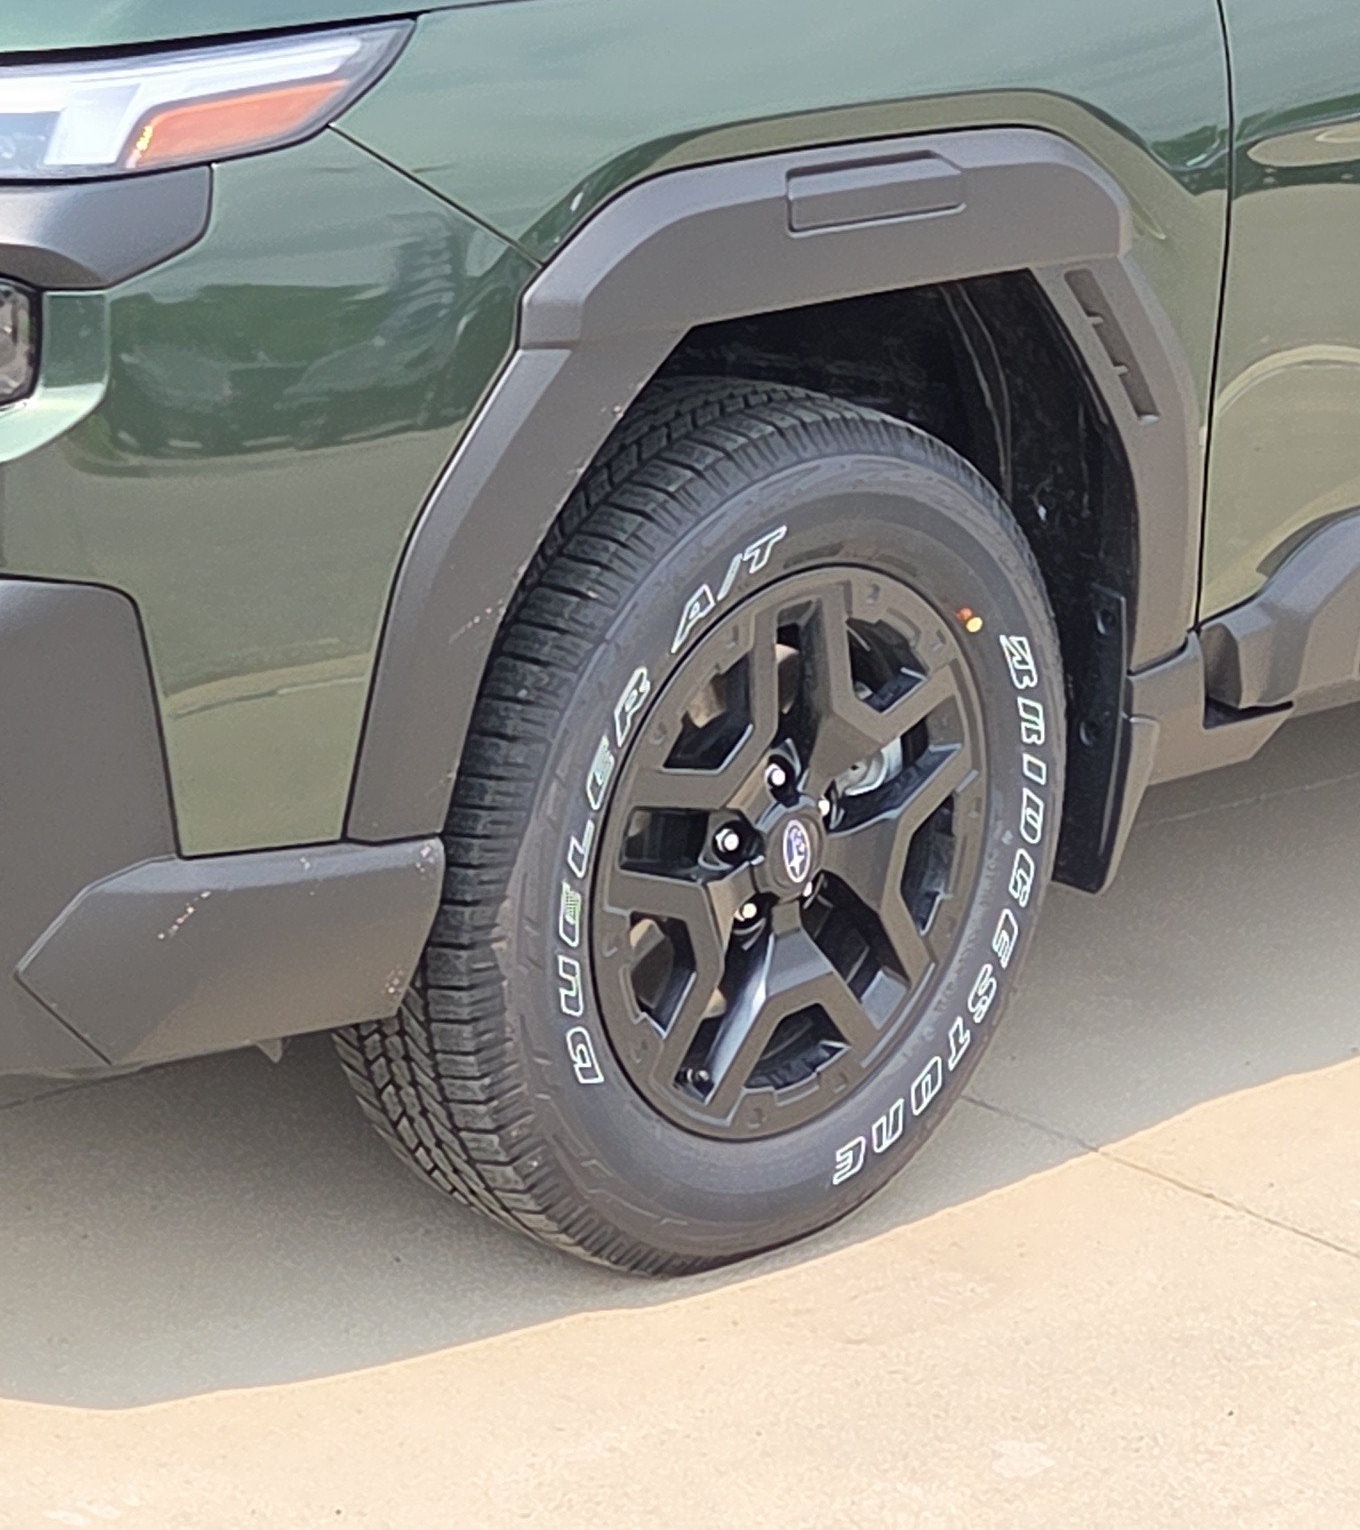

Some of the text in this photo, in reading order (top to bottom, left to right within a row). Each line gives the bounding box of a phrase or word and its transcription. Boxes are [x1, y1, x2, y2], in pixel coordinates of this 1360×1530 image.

[557, 524, 788, 1085] DUELER A/T
[831, 634, 1047, 1186] BRIDGESTONE
